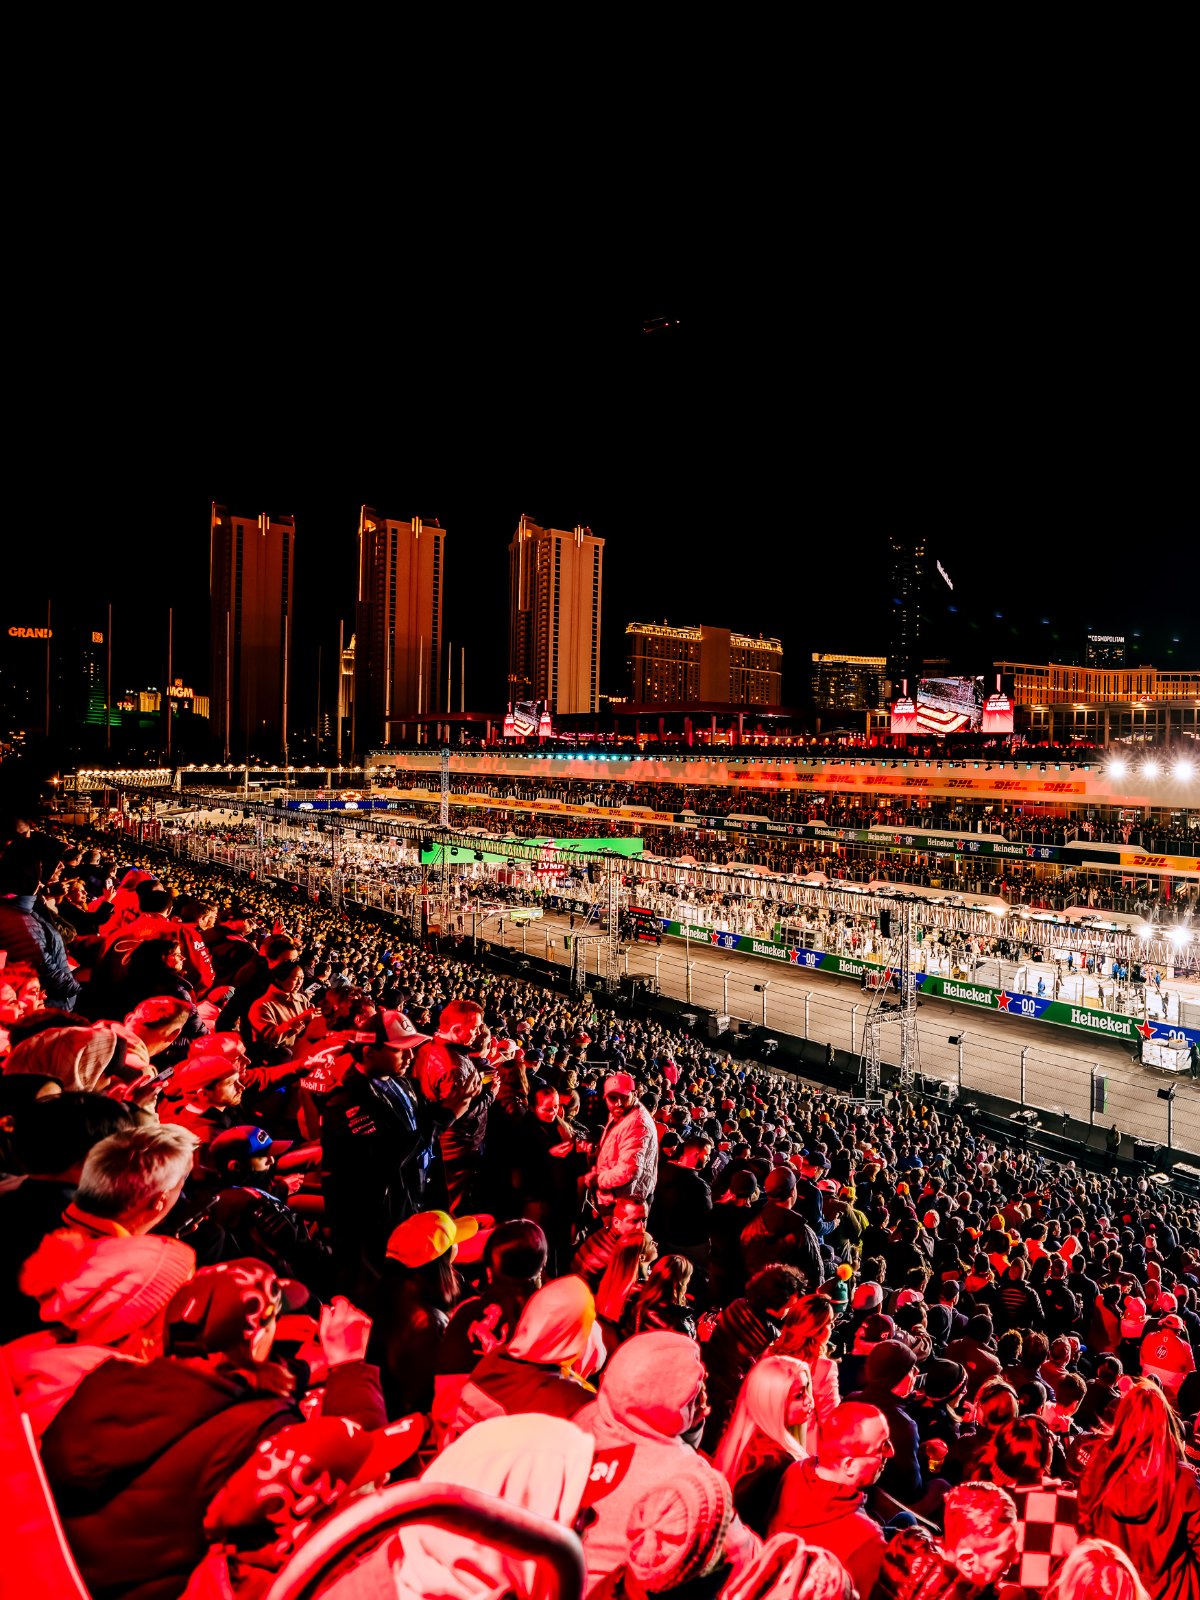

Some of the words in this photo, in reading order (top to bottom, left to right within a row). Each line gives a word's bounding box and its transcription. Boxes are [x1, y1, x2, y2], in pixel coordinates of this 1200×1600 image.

[8, 627, 52, 638] GRAND
[167, 687, 194, 698] MGM
[828, 774, 850, 783] DHL
[866, 776, 888, 785] DHL
[906, 778, 930, 786] DHL
[948, 779, 974, 788] DHL
[994, 780, 1021, 790] DHL
[1044, 782, 1074, 792] DHL
[767, 824, 786, 832] Heineken
[815, 828, 836, 836] Heineken
[868, 833, 892, 842] Heineken
[928, 838, 954, 848] Heineken
[994, 844, 1022, 854] Heineken
[1132, 856, 1168, 868] DHL
[680, 925, 708, 940] Heineken
[752, 941, 786, 958] Heineken
[839, 960, 878, 976] Heineen
[943, 982, 992, 1004] Heineken
[1071, 1009, 1132, 1035] Heineken
[300, 1078, 318, 1091] Mobil
